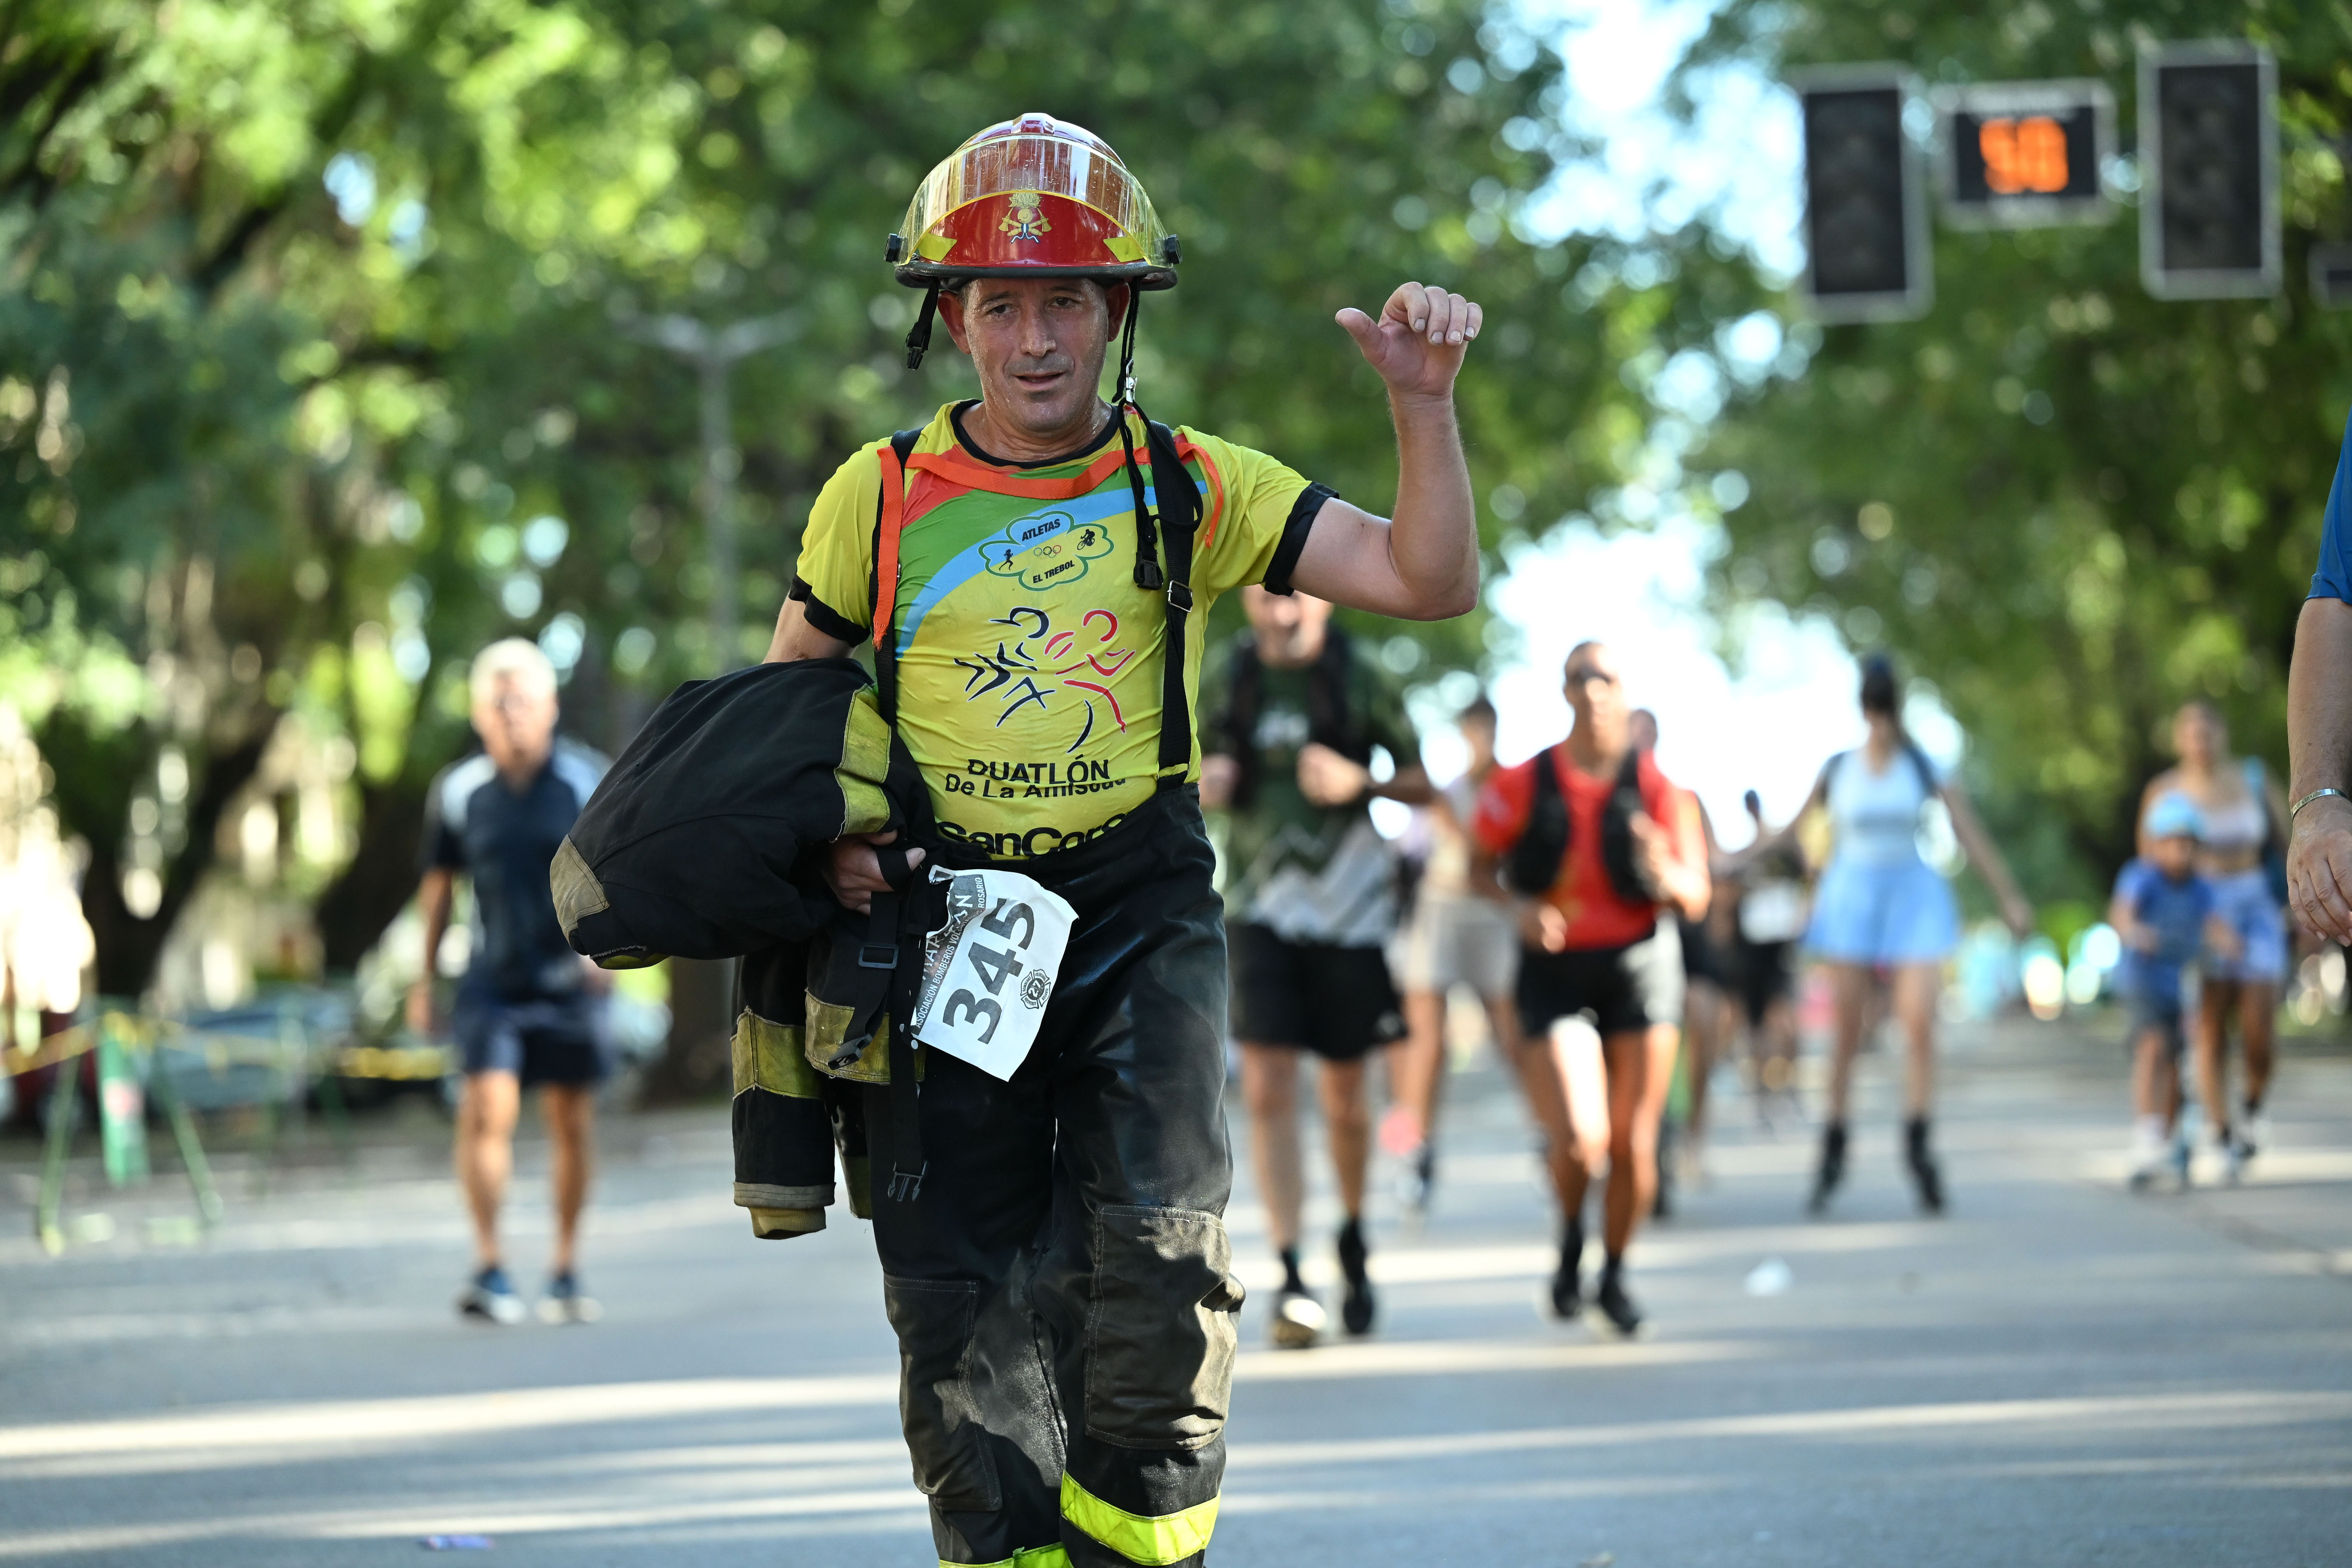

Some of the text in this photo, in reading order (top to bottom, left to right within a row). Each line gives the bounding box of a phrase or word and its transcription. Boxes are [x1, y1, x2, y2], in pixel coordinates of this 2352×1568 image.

[1022, 518, 1060, 541] ATLETAS
[1033, 560, 1075, 584] EL TREBOL
[968, 754, 1110, 784] DUATLÓN
[945, 773, 975, 795] De
[982, 779, 1014, 798] La
[915, 984, 938, 1028] ASOCIACIÓN
[932, 945, 955, 984] BOMBEROS
[975, 877, 985, 908] ROSARIO
[943, 898, 1034, 1045] 345
[1028, 980, 1041, 998] 27
